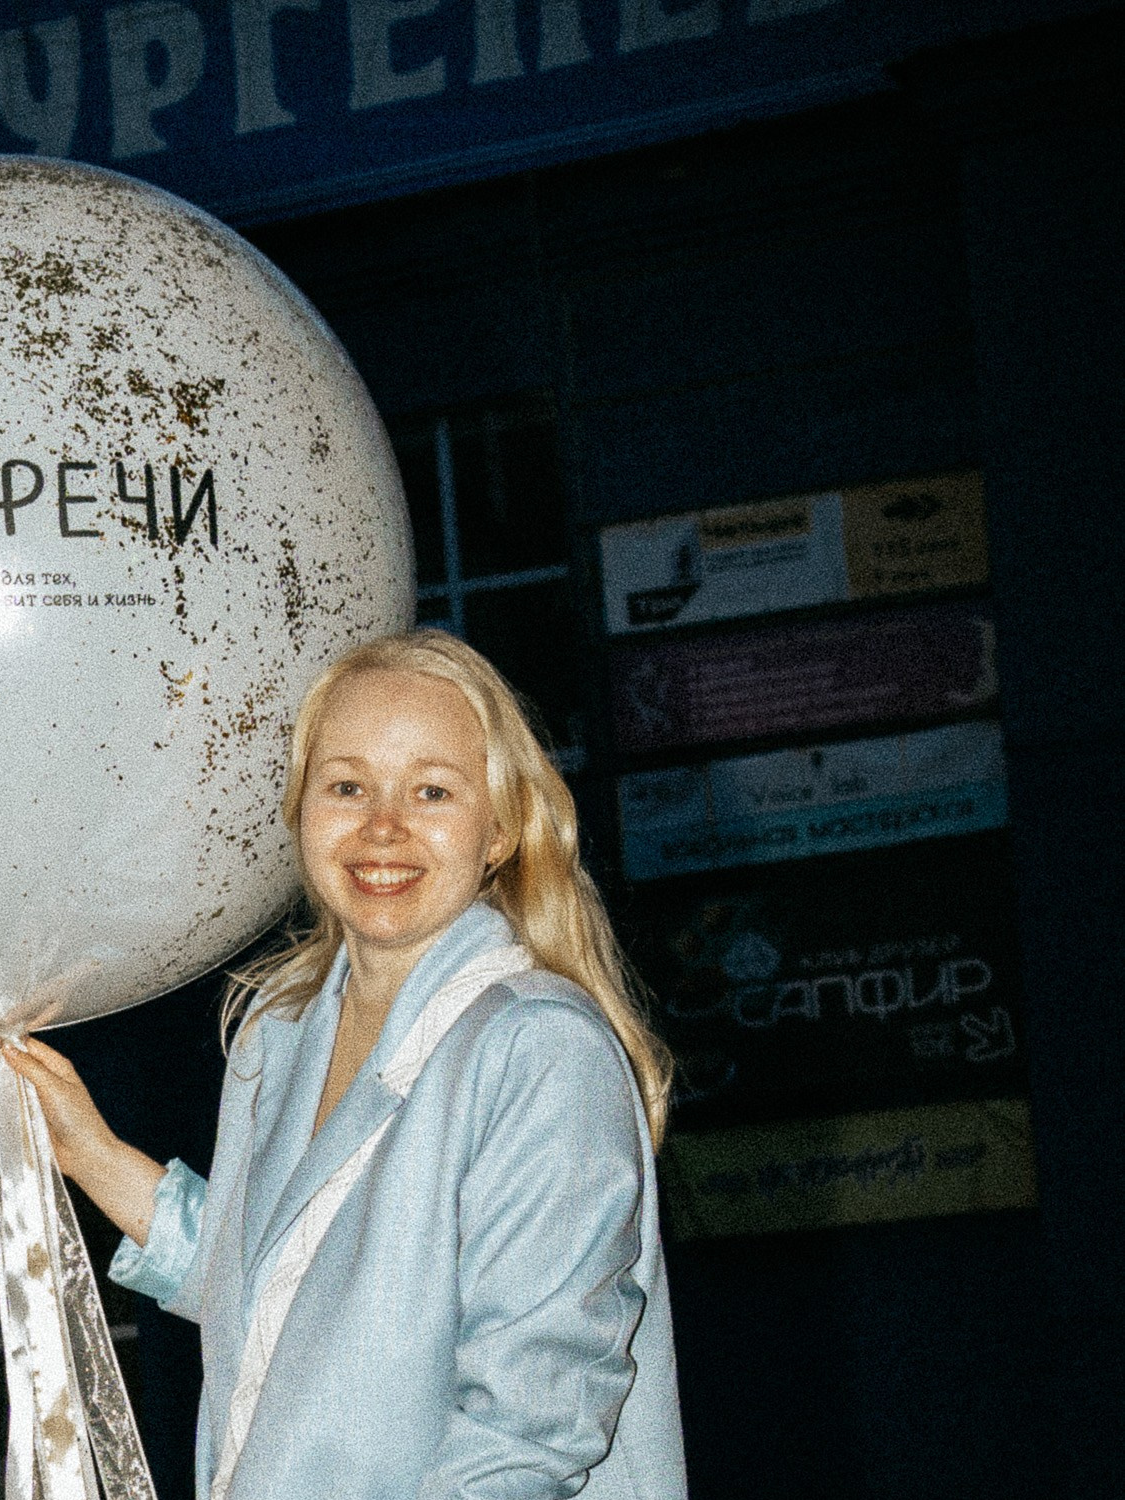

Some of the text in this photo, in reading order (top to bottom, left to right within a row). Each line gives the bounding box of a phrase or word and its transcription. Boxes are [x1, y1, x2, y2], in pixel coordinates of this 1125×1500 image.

[1, 570, 35, 586] для
[41, 571, 77, 589] тех,
[42, 593, 83, 607] себя
[87, 593, 99, 606] и
